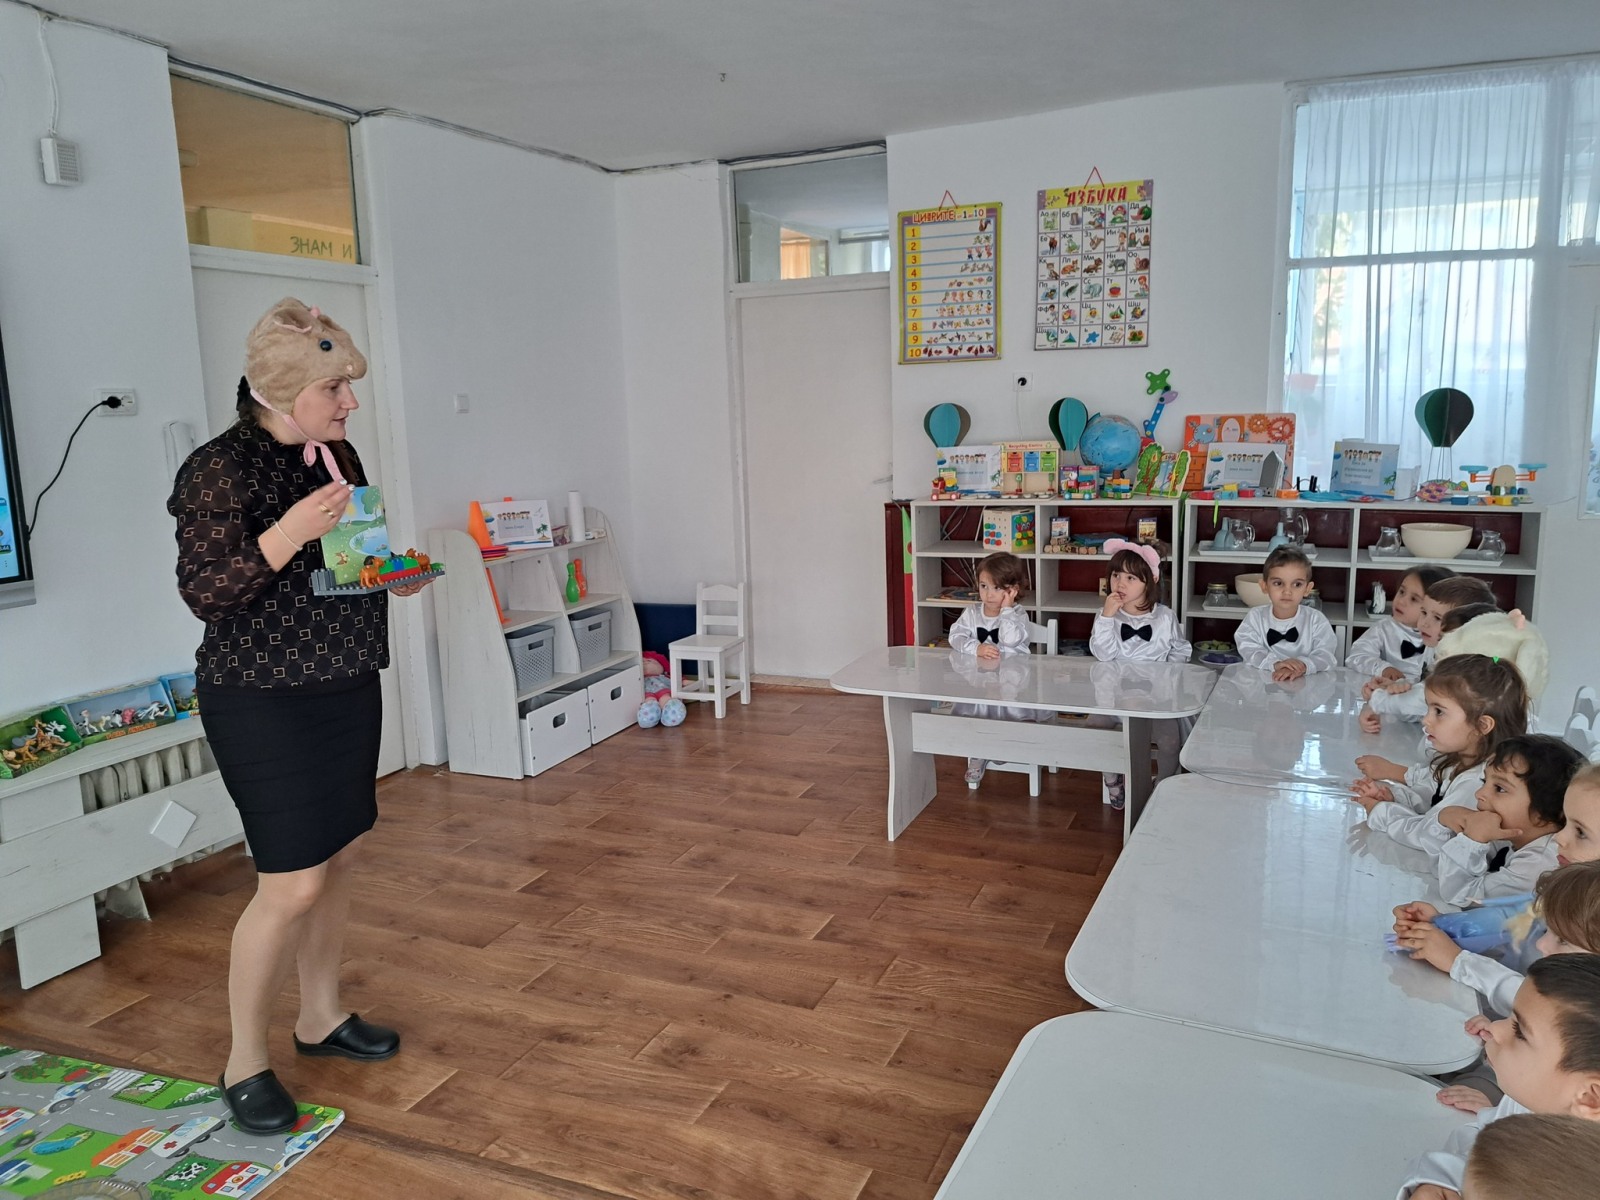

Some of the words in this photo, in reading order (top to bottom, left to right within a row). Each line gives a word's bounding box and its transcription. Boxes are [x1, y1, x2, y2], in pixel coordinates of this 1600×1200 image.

[1067, 186, 1127, 206] АЗБУКА
[963, 210, 967, 219] 1
[974, 208, 984, 217] 10
[911, 229, 916, 237] 1
[290, 236, 333, 257] ЗНАМ
[342, 243, 352, 259] И
[911, 242, 916, 251] 2
[911, 256, 917, 264] 3
[911, 269, 917, 277] 4
[1129, 277, 1137, 285] Уу
[912, 282, 917, 291] 5
[912, 296, 917, 304] 6
[912, 309, 917, 318] 7
[912, 322, 918, 331] 8
[913, 335, 918, 344] 9
[910, 349, 921, 358] 10
